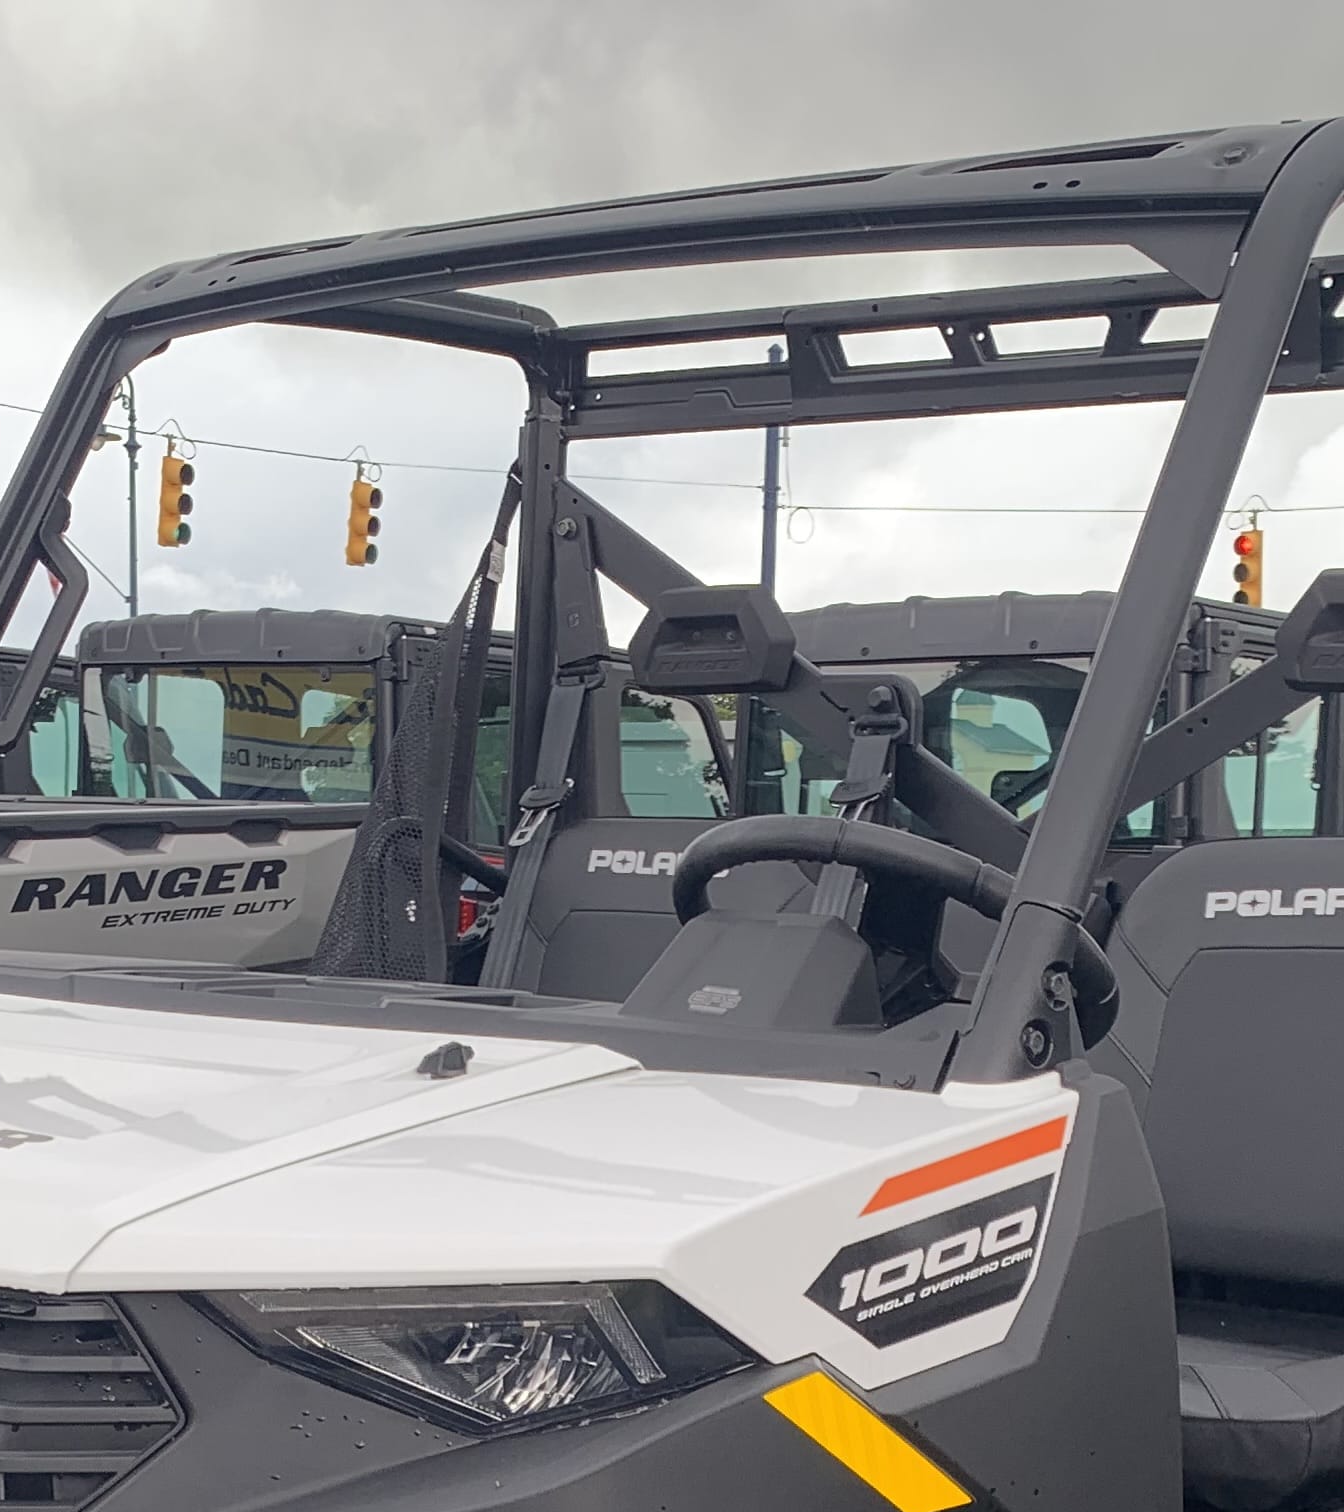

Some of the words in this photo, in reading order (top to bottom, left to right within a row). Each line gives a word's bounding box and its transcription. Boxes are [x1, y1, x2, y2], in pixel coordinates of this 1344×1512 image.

[10, 858, 288, 913] RANGER
[101, 904, 226, 929] EXTREME
[232, 897, 297, 916] DUTY
[838, 1205, 1039, 1312] 1000
[856, 1291, 916, 1323] SINGLE
[919, 1260, 1000, 1299] OVERHEAD
[1000, 1247, 1034, 1268] CAM
